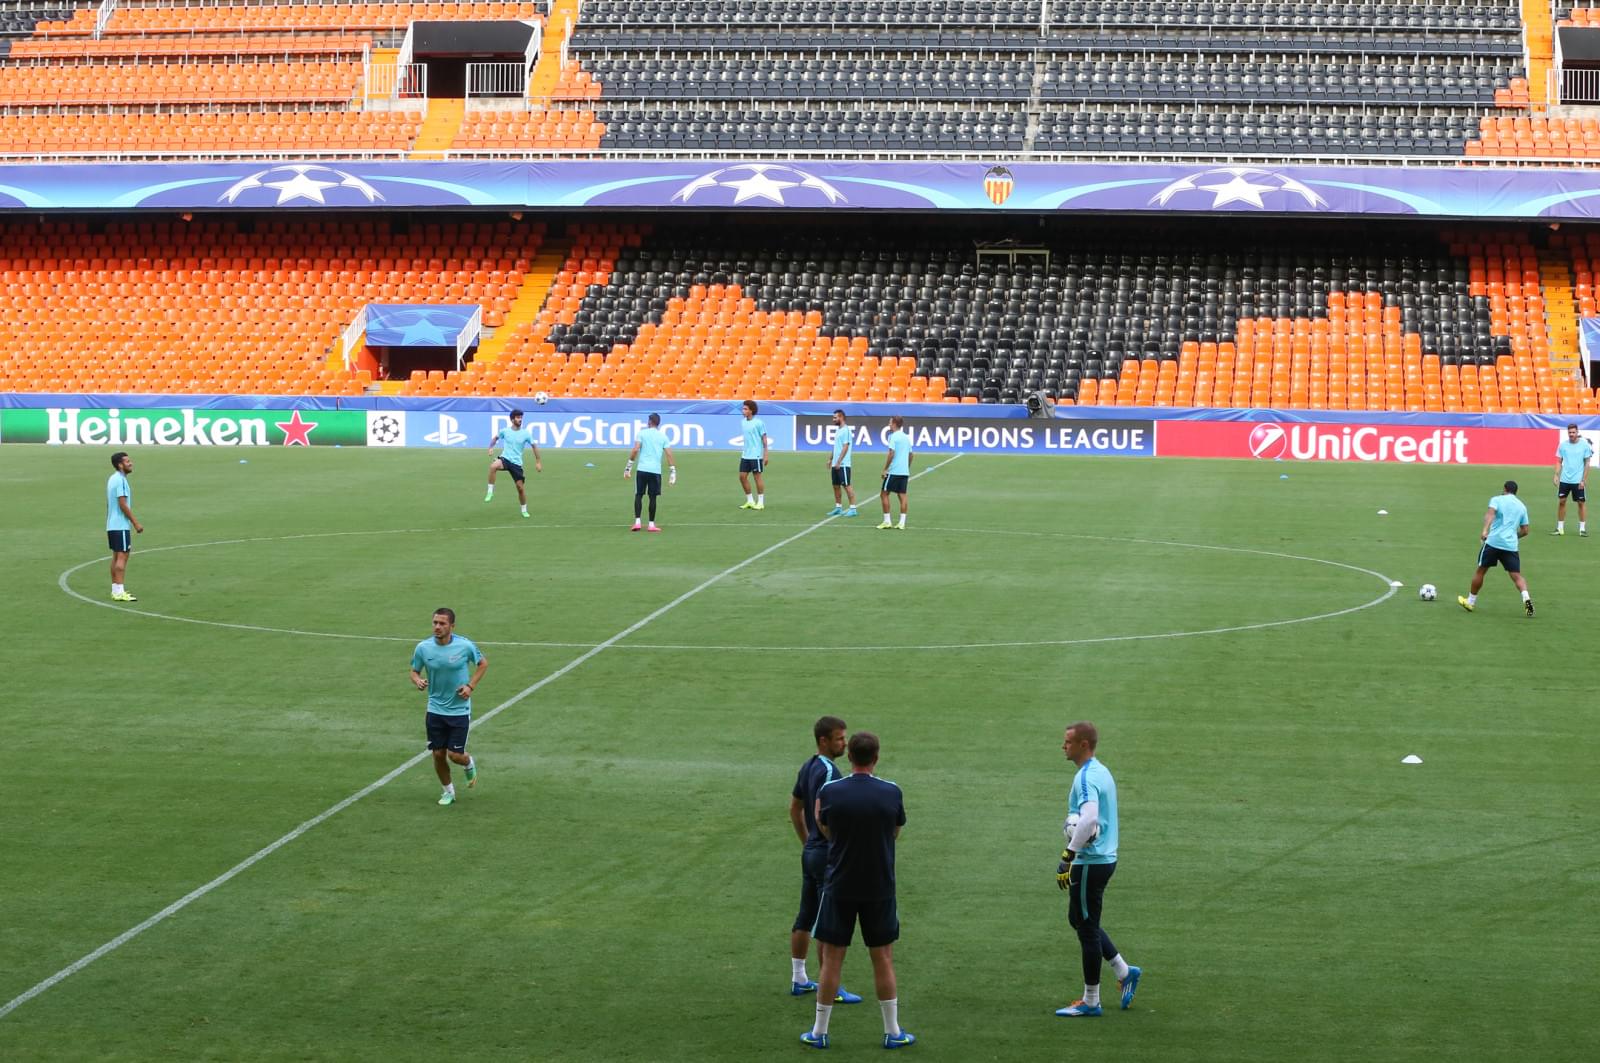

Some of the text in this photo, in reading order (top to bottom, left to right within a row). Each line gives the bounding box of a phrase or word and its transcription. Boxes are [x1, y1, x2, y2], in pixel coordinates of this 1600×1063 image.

[45, 408, 270, 446] Heineken
[491, 415, 705, 448] PayStaton
[1045, 427, 1145, 450] LEAGUE
[1291, 425, 1469, 463] UniCredit
